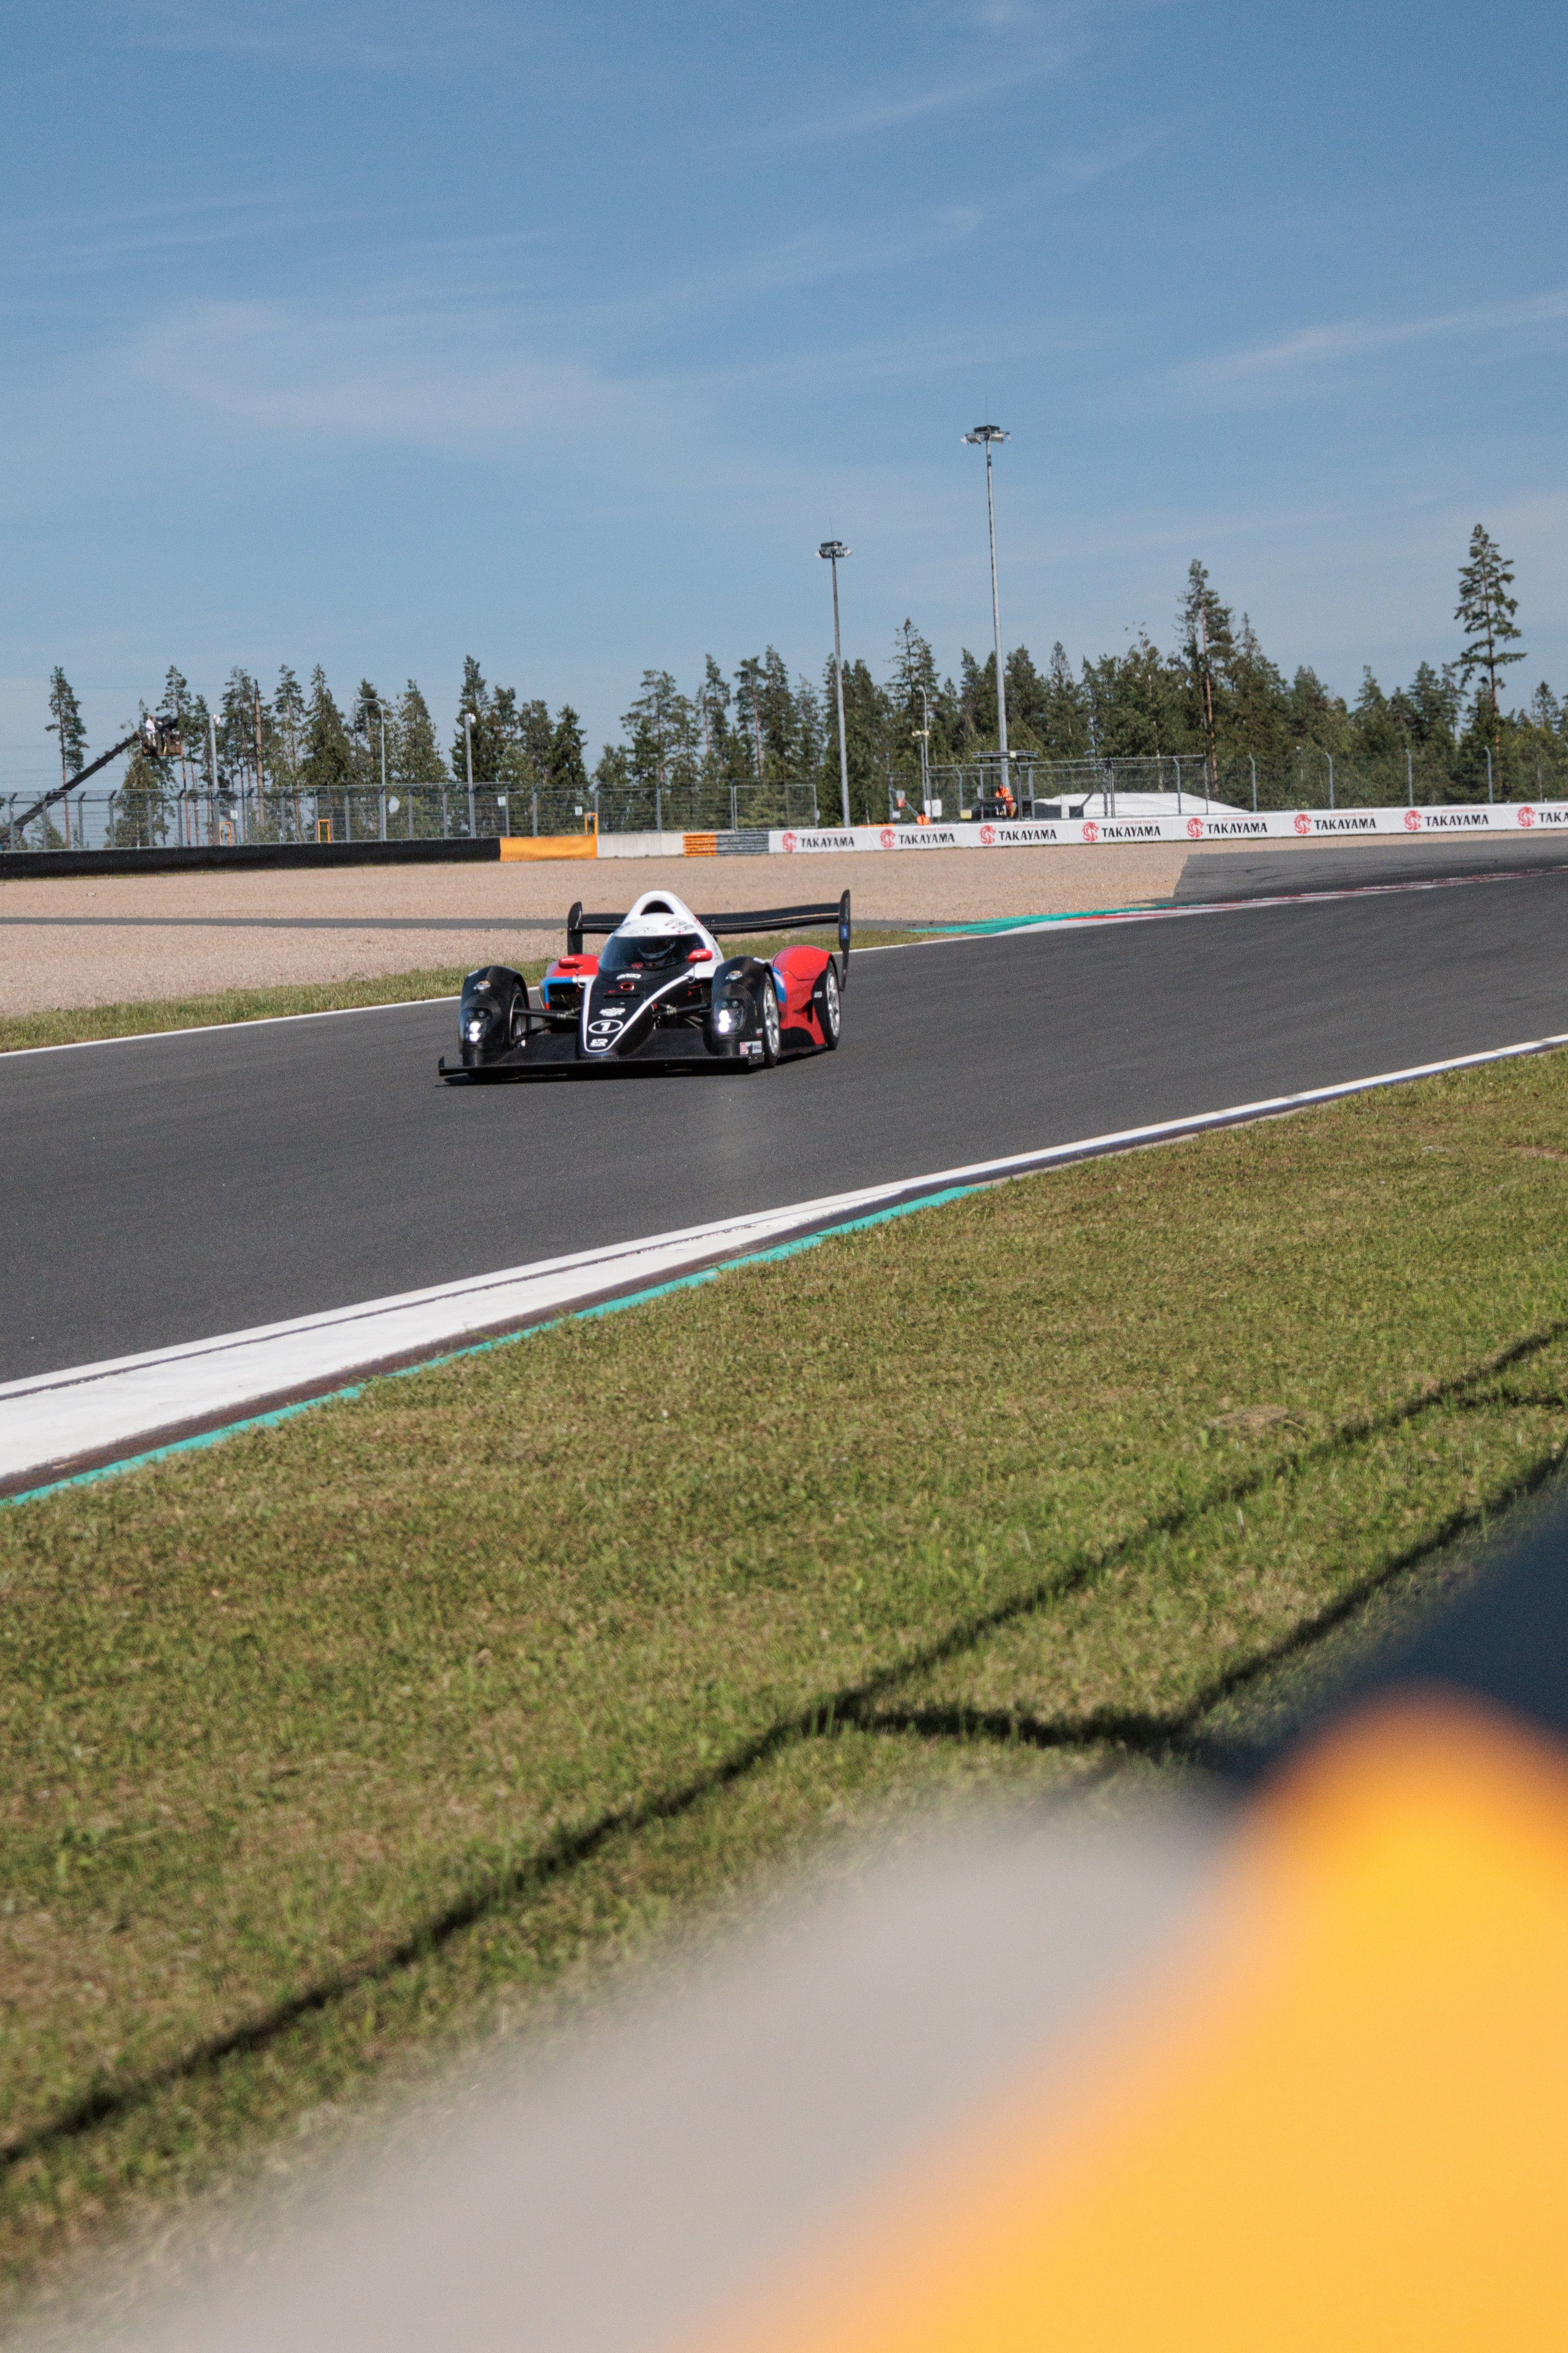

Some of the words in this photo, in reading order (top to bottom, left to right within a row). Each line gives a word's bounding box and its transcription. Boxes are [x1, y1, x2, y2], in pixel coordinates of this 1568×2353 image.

[1314, 818, 1376, 830] TAKAYAMA
[1425, 814, 1489, 826] TAKAYAMA
[1102, 826, 1161, 837] TAKAYAMA
[1207, 823, 1267, 834] TAKAYAMA
[899, 833, 955, 844] TAKAYAMA
[998, 829, 1057, 840] TAKAYAMA
[801, 836, 854, 847] TAKAYAMA
[600, 1022, 611, 1032] 1
